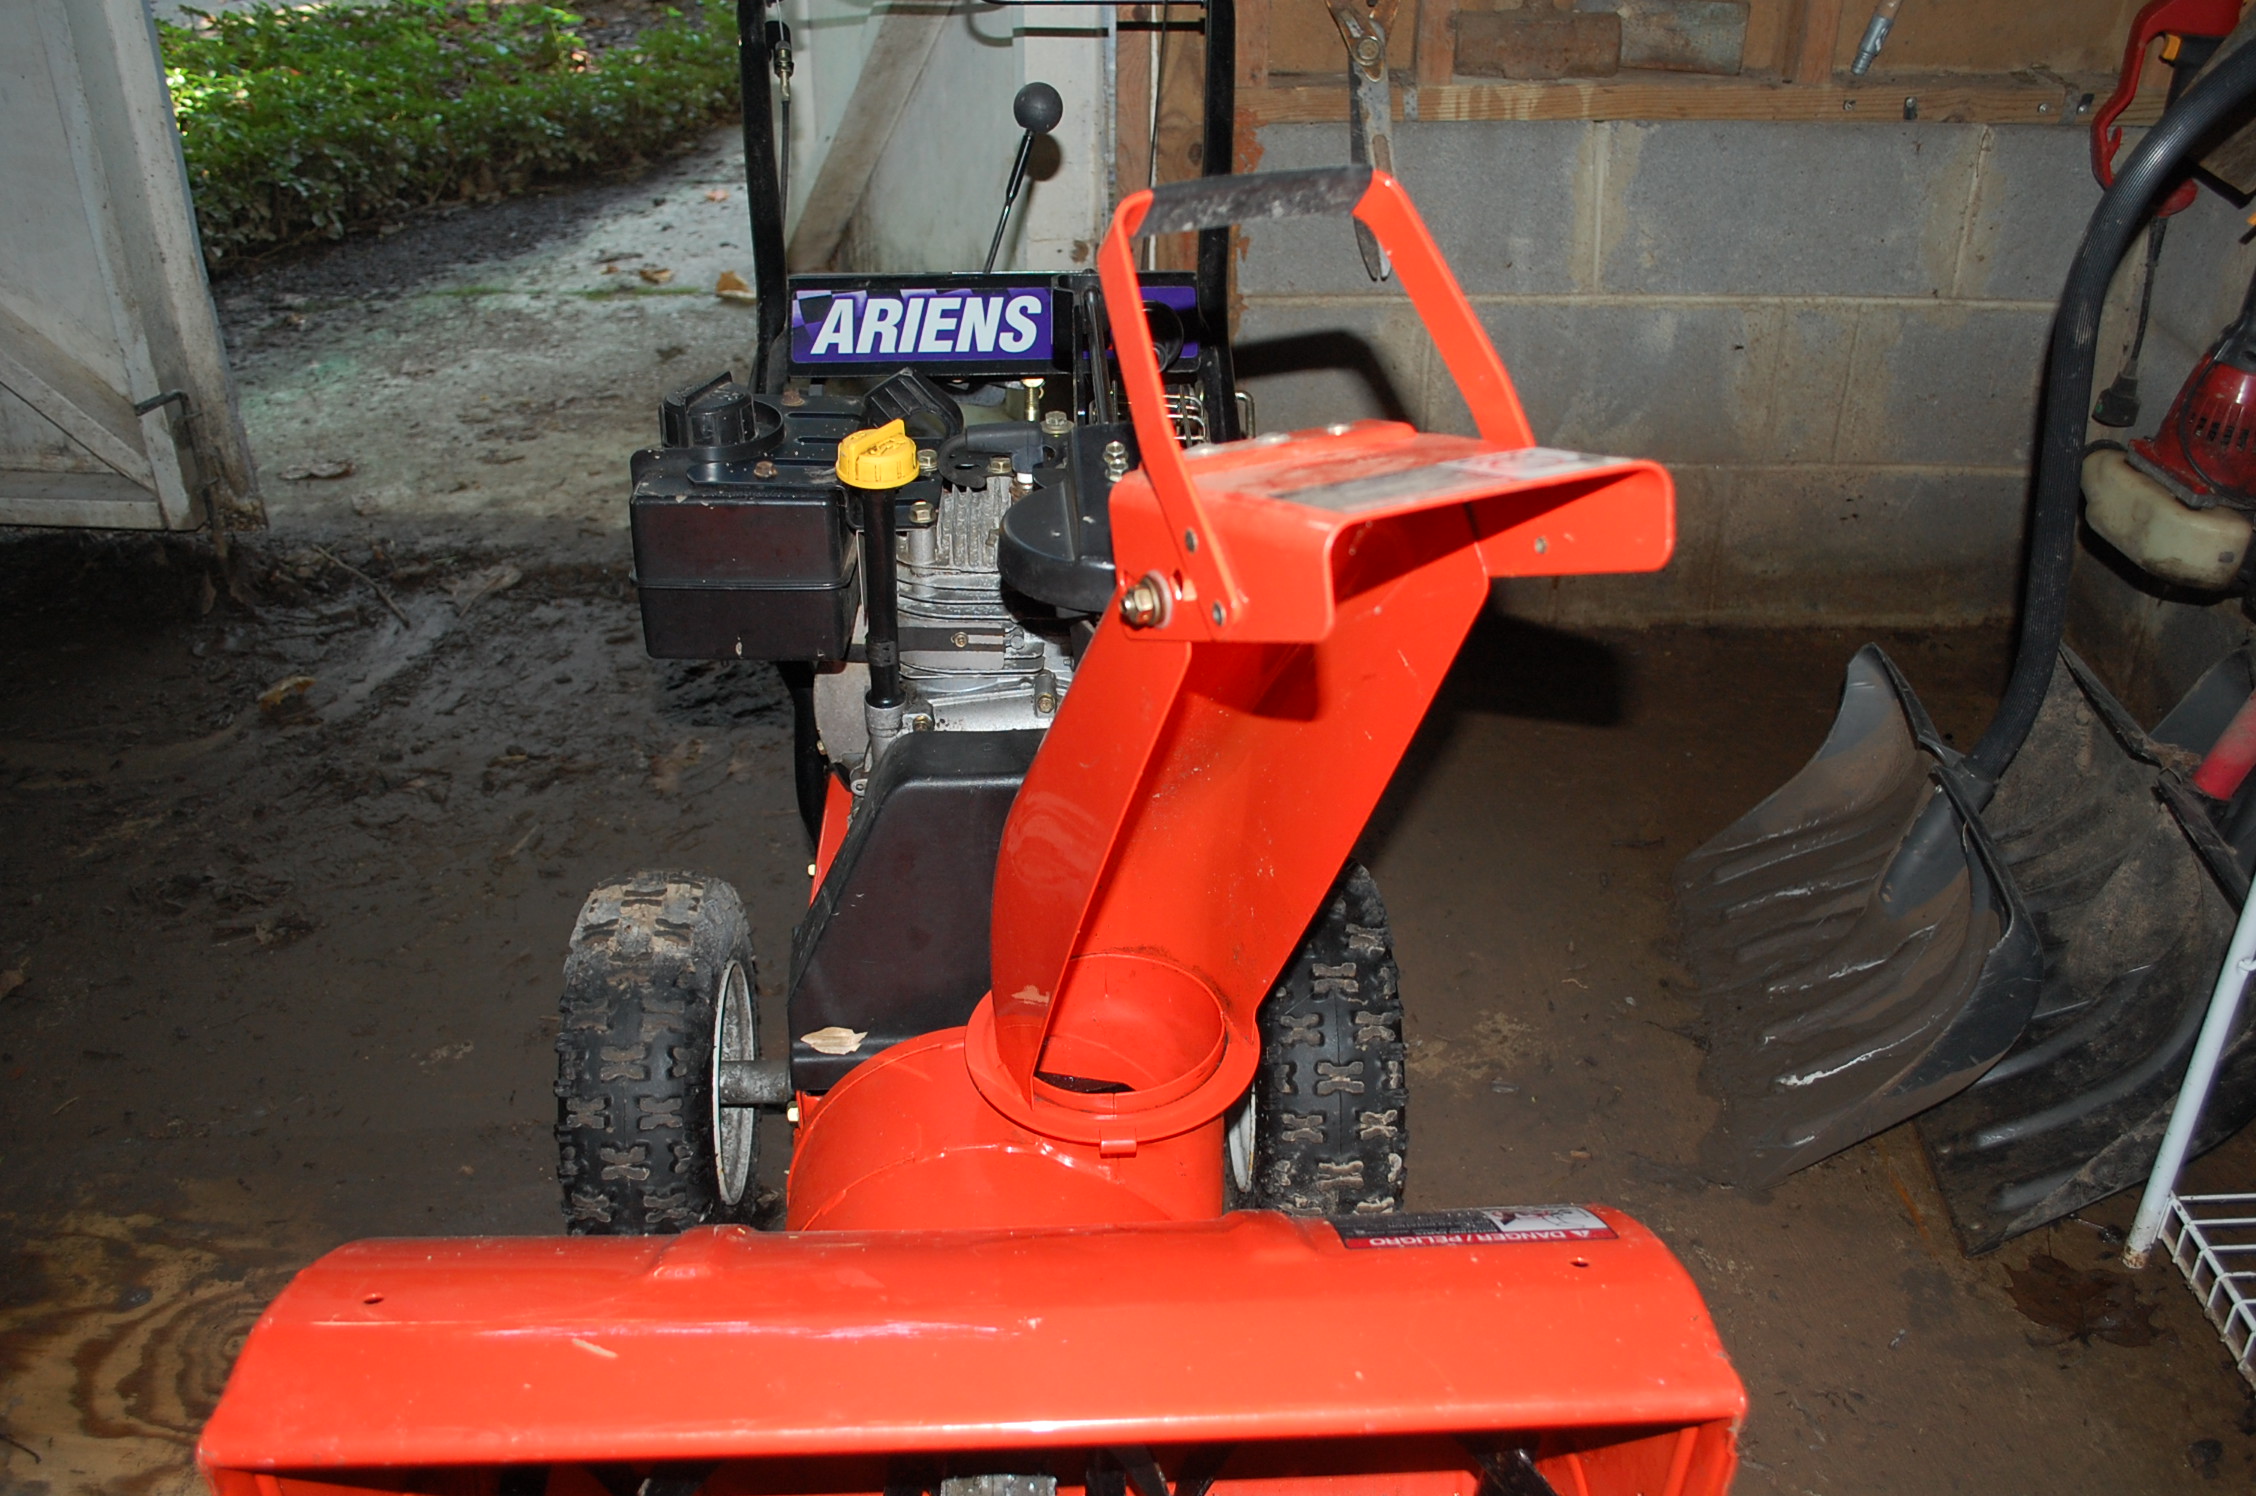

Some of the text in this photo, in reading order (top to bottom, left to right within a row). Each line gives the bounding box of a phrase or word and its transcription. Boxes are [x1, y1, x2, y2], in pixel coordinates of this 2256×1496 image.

[810, 295, 1041, 354] ARIENS
[1369, 1234, 1463, 1246] PELIGRO
[1475, 1230, 1567, 1242] DANGER
